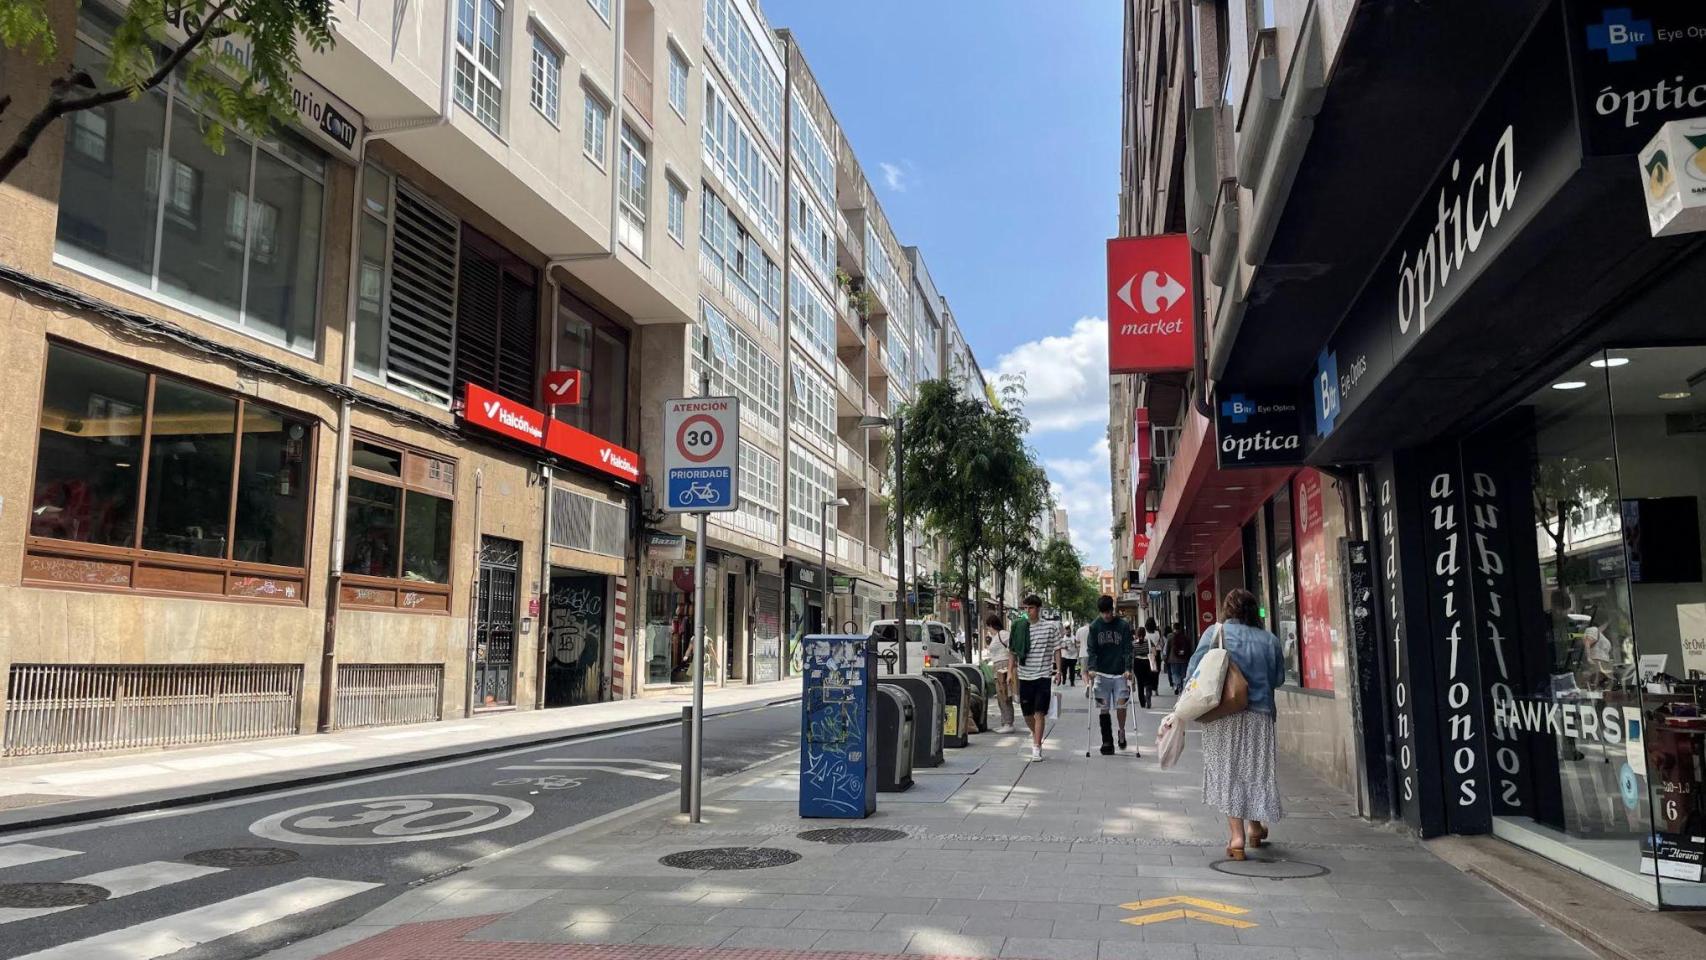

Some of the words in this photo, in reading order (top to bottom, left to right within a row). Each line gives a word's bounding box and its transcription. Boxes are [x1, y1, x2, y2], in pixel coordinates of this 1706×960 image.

[1658, 29, 1684, 42] Eye
[1398, 124, 1522, 335] óptica
[1121, 318, 1183, 335] market
[1341, 375, 1351, 399] Eye
[1350, 355, 1367, 387] Optics
[499, 407, 529, 433] Halcón
[1257, 406, 1271, 414] Eye
[687, 430, 713, 446] 30
[1222, 430, 1300, 460] óptica
[671, 470, 729, 479] PRIORIDADE
[1494, 698, 1621, 744] HAWKERS
[294, 799, 500, 836] 30
[1666, 800, 1678, 820] 6
[1668, 848, 1700, 860] Horario
